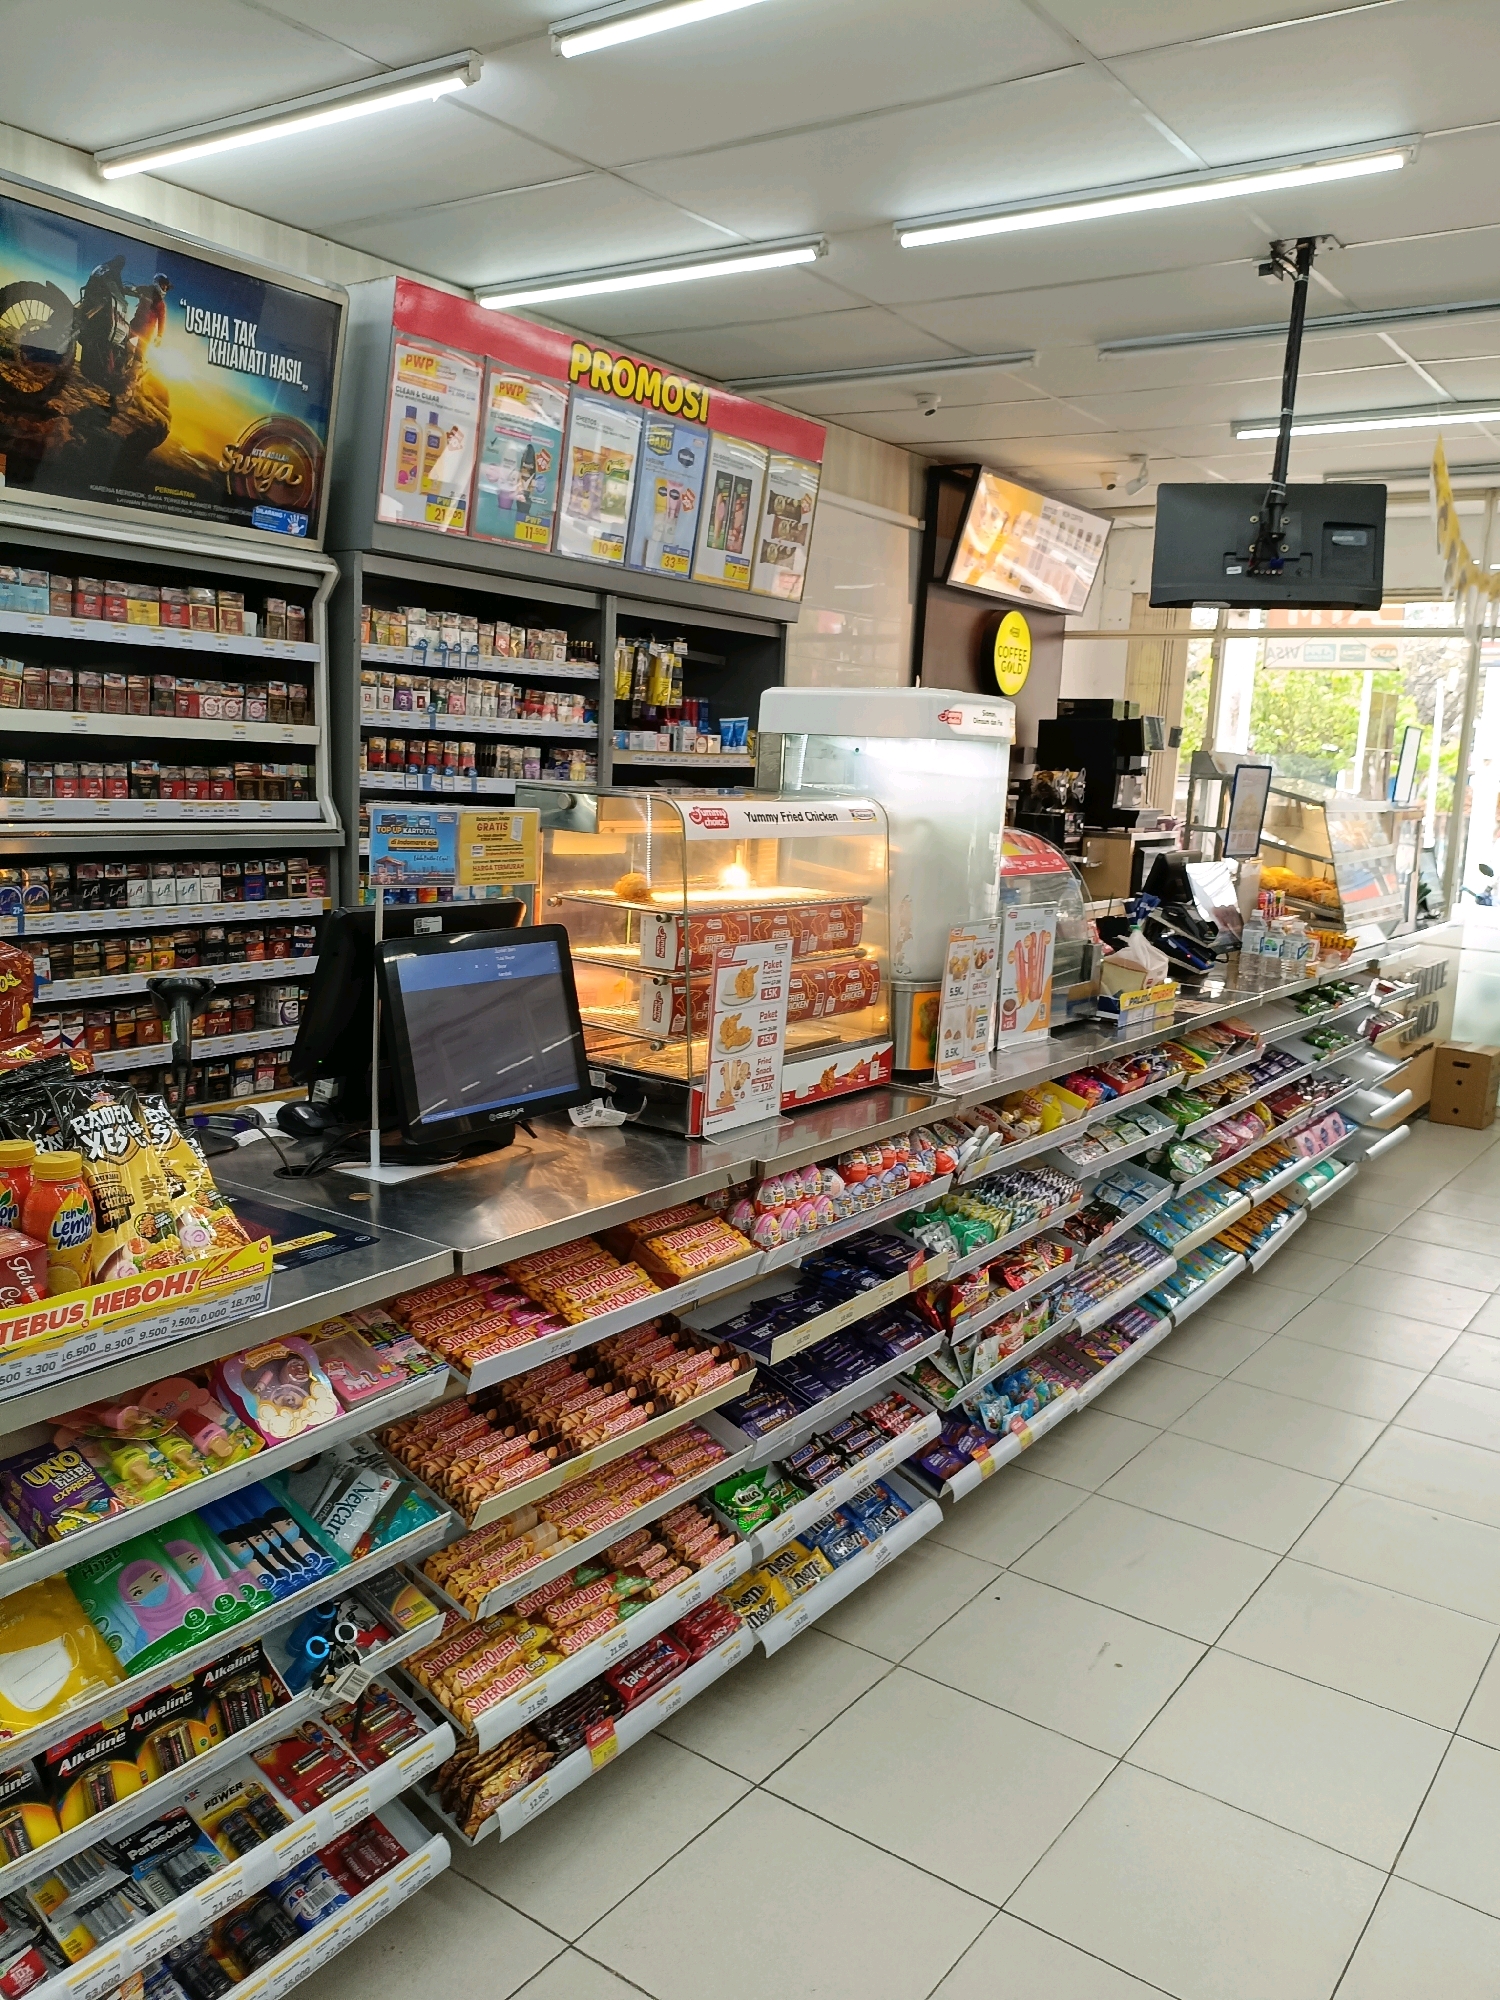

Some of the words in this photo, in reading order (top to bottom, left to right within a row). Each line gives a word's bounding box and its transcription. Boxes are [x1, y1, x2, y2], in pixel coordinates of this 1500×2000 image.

[234, 319, 257, 347] TAK
[209, 338, 267, 375] KHIANATI
[405, 354, 434, 370] PWP
[499, 382, 524, 397] PWP
[570, 343, 709, 423] PROMOSI
[219, 444, 302, 492] Surya
[998, 646, 1027, 662] COFFEE
[1001, 660, 1023, 675] GOLD
[376, 826, 391, 834] TOP
[392, 826, 402, 834] UP
[477, 822, 508, 831] GRATIS
[744, 811, 779, 825] Yummy
[780, 811, 803, 822] Fried
[805, 811, 838, 822] Chicken
[158, 883, 172, 897] LA
[12, 907, 23, 915] 21+
[705, 935, 726, 944] FRIED
[772, 929, 790, 938] FRIED
[828, 923, 845, 932] FRIED
[763, 960, 782, 970] Paket
[763, 988, 778, 999] 15K
[840, 991, 865, 1001] CHICKEN
[845, 983, 862, 992] FRIED
[759, 1010, 778, 1020] Paket
[760, 1034, 775, 1044] 25K
[756, 1066, 772, 1076] Snack
[757, 1056, 772, 1066] Fried
[760, 1083, 774, 1092] 12K
[974, 1107, 998, 1123] nutella
[1023, 1095, 1043, 1112] EGG
[70, 1104, 134, 1135] RAMEN
[81, 1127, 127, 1160] YES
[52, 1213, 94, 1239] Lemon
[60, 1211, 77, 1222] Teh
[640, 1204, 697, 1232] SILVERQUEEN
[58, 1233, 92, 1251] Madu
[661, 1219, 723, 1250] SILVERQUEEN
[519, 1238, 592, 1273] SILVERQUEEN
[680, 1233, 740, 1267] SILVERQUEEN
[6, 1256, 32, 1286] Teh
[540, 1256, 607, 1291] SILVERQUEEN
[566, 1265, 638, 1302] SILVERQUEEN
[0, 1303, 84, 1345] TEBUS
[92, 1270, 200, 1317] HEBOH!
[231, 1292, 261, 1307] 18.700
[399, 1278, 470, 1312] SILVERQUEEN
[581, 1284, 649, 1316] SILVERQUEEN
[412, 1299, 485, 1337] SILVERQUEEN
[104, 1336, 133, 1353] 8.300
[139, 1326, 167, 1341] 9.500
[438, 1314, 511, 1351] SILVERQUEEN
[467, 1328, 537, 1362] SILVERQUEEN
[25, 1361, 55, 1377] 3.300
[696, 1361, 734, 1388] SILVERQUEEN
[586, 1391, 629, 1417] SILVERQUEEN
[604, 1405, 648, 1433] SILVERQUEEN
[455, 1430, 506, 1460] SILVERQUEEN
[480, 1434, 530, 1465] SILVERQUEEN
[791, 1444, 814, 1466] SNICKERS
[22, 1451, 82, 1488] UNO
[52, 1463, 92, 1489] FLIP!
[499, 1451, 550, 1481] SILVERQUEEN
[807, 1454, 831, 1477] SNICKERS
[820, 1466, 845, 1486] SNICKERS
[52, 1473, 96, 1502] EXPRESS
[542, 1481, 595, 1516] SILVERQUEEN
[737, 1491, 762, 1505] MILO
[560, 1496, 613, 1531] SILVERQUEEN
[584, 1501, 637, 1534] SILVERQUEEN
[81, 1547, 122, 1581] Hijab
[514, 1574, 575, 1617] SILVERQUEEN
[546, 1580, 613, 1621] SILVERQUEEN
[482, 1617, 504, 1634] Crispy
[514, 1627, 538, 1644] Crispy
[561, 1606, 618, 1654] SILVERQUEEN
[421, 1628, 488, 1678] SILVERQUEEN
[609, 1640, 629, 1657] 21.500
[203, 1649, 260, 1688] Alkaline
[456, 1636, 521, 1688] SILVERQUEEN
[526, 1656, 548, 1673] Crispy
[464, 1665, 532, 1716] SILVERQUEEN
[130, 1690, 193, 1732] Alkaline
[526, 1696, 549, 1715] 21.500
[58, 1731, 126, 1778] Alkaline
[184, 1789, 200, 1802] ABC
[204, 1780, 245, 1811] POWER
[127, 1818, 191, 1861] Panasonic
[212, 1889, 244, 1913] 21.500
[145, 1934, 180, 1960] 32.500
